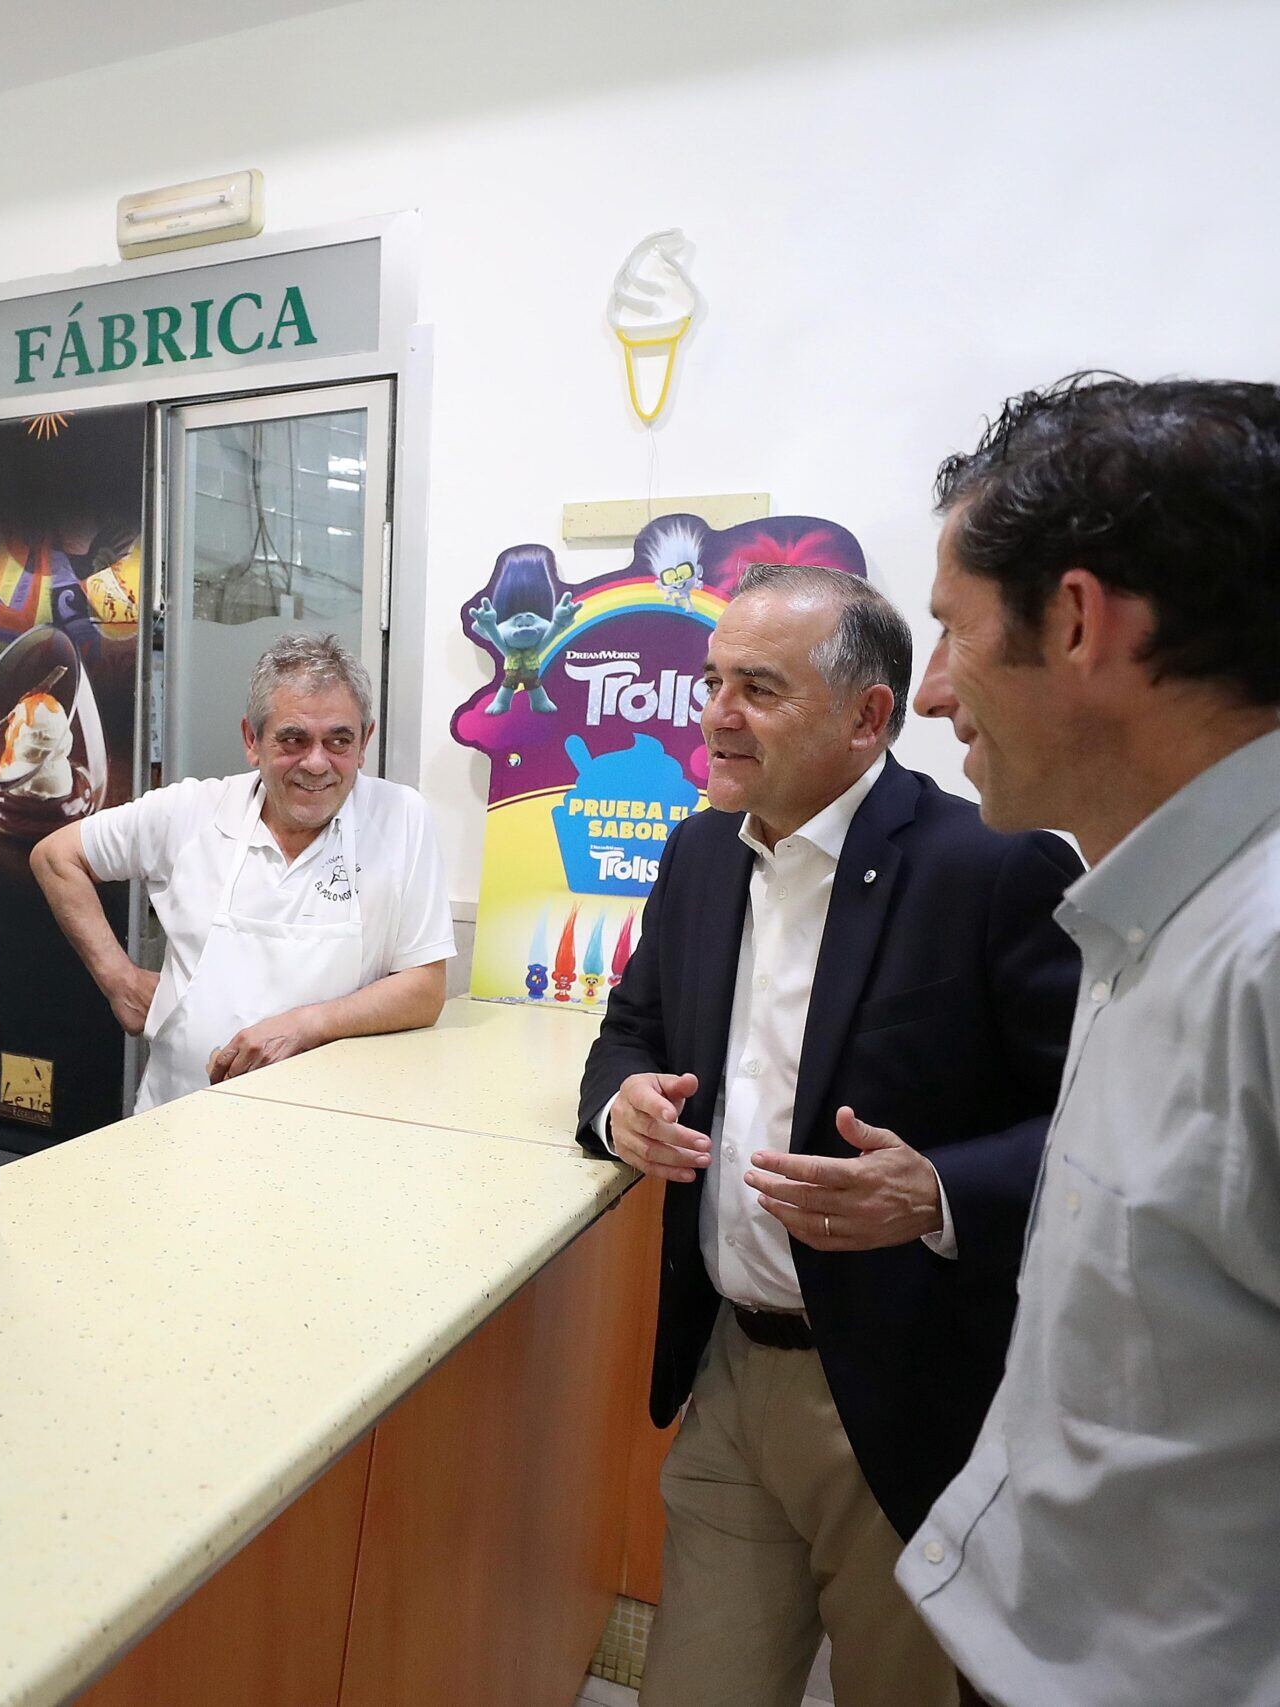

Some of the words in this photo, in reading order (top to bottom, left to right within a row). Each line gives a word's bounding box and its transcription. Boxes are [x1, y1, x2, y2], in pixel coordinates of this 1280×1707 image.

[14, 285, 318, 385] FÁBRICA
[568, 798, 664, 821] PRUEBA
[588, 820, 669, 841] SABOR
[589, 849, 660, 883] Trolls
